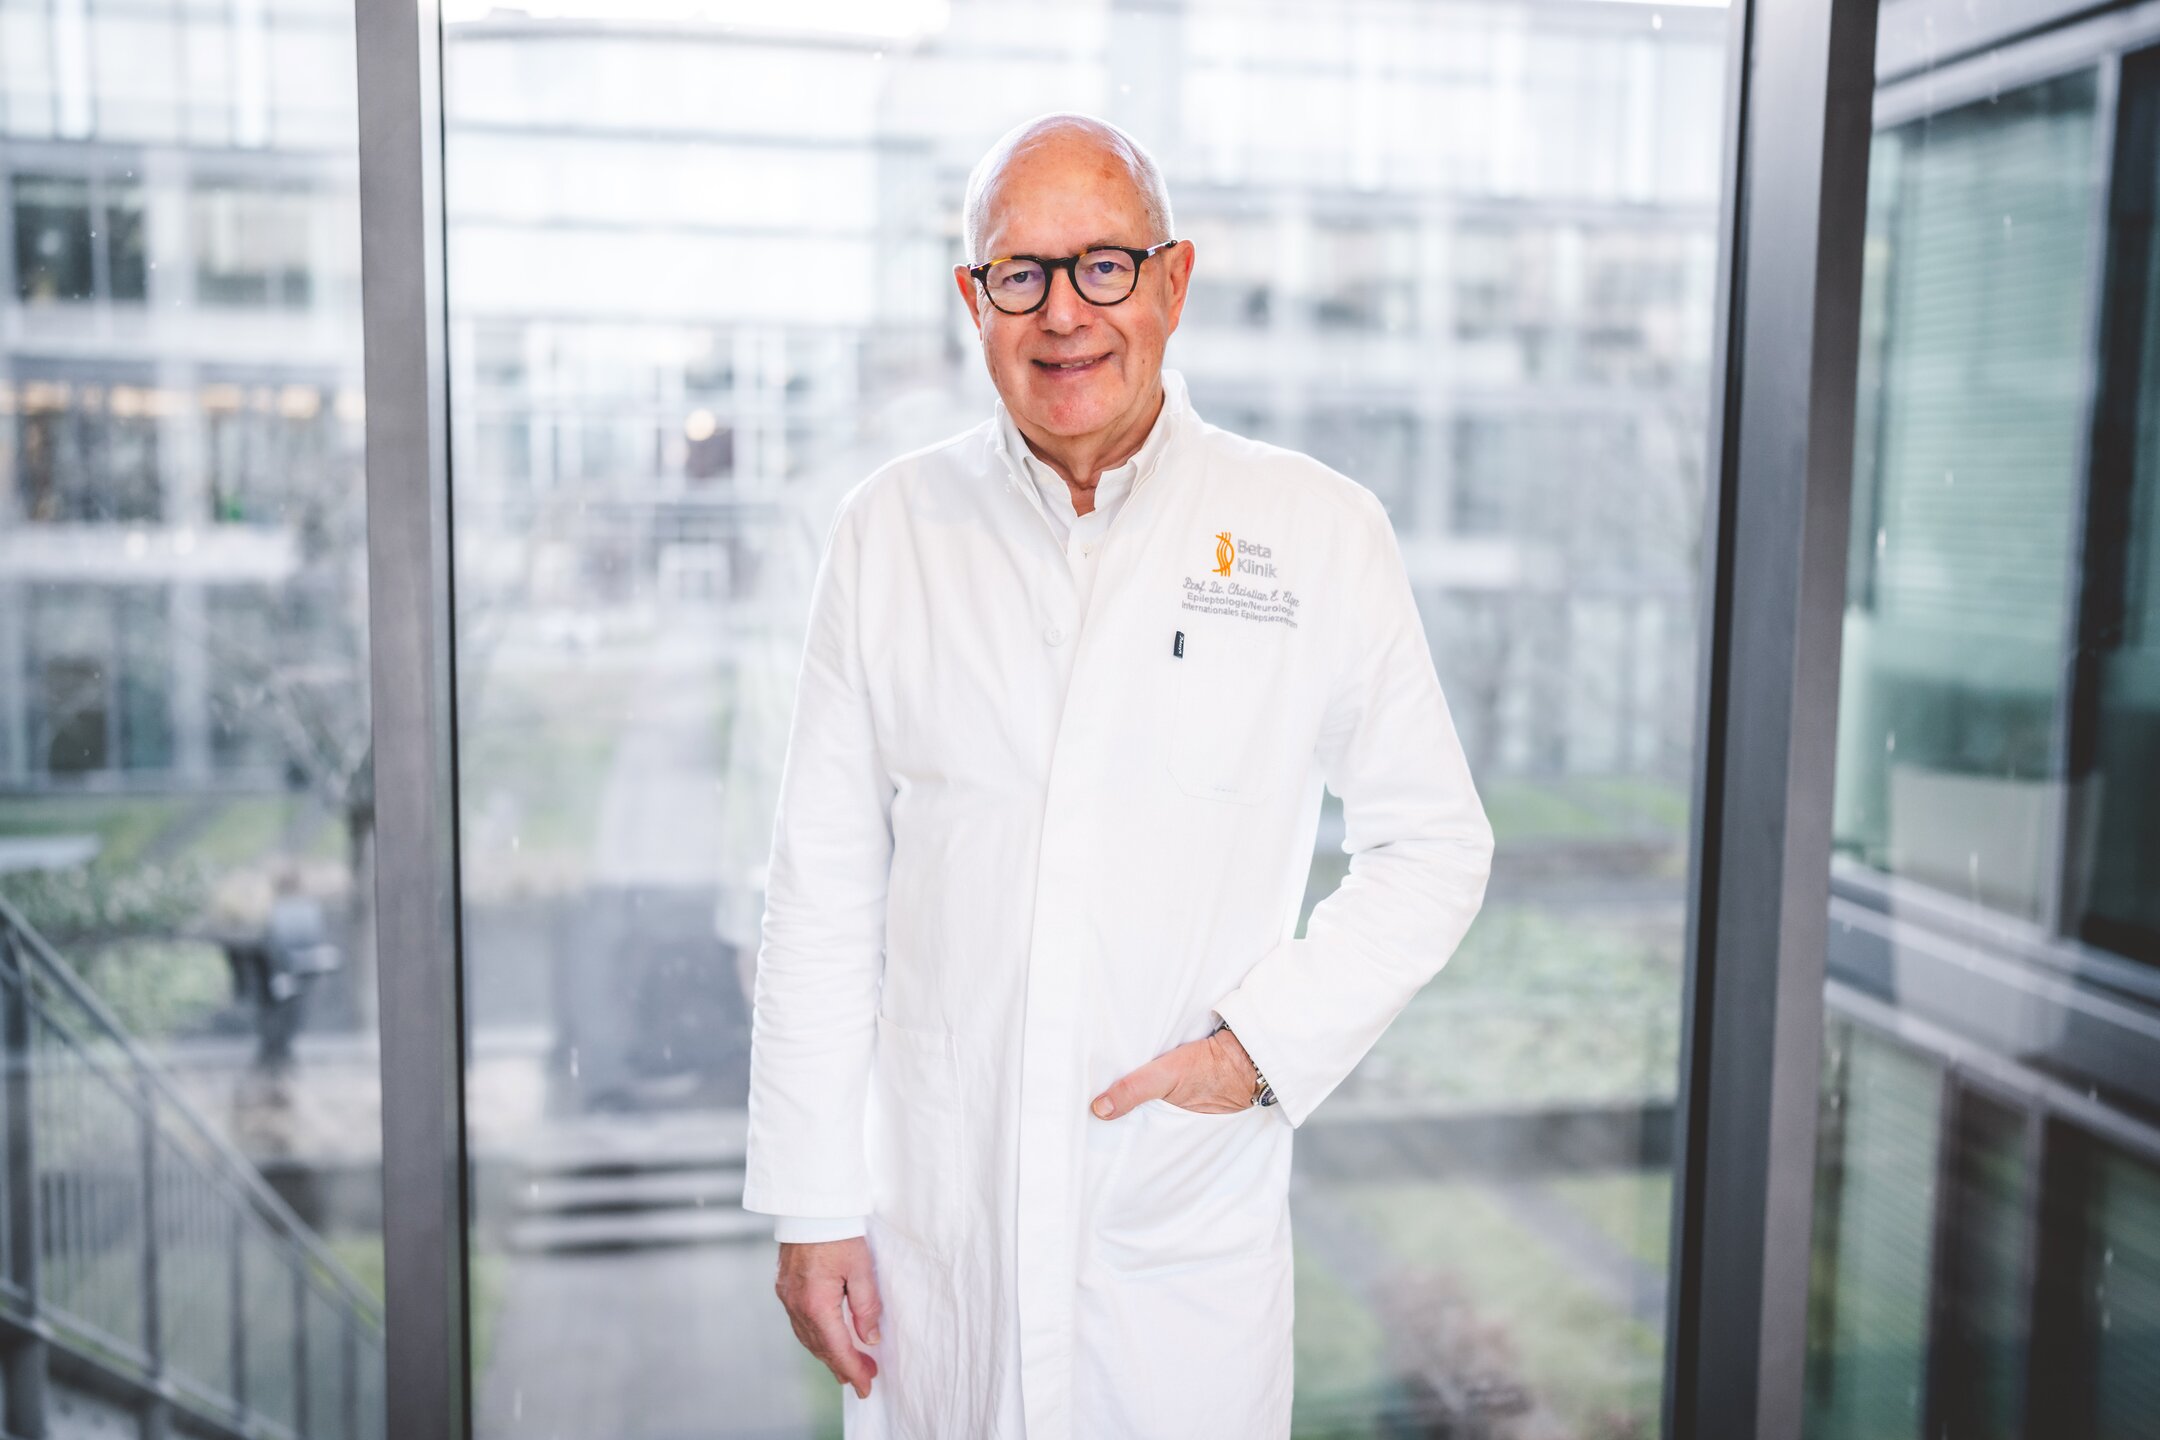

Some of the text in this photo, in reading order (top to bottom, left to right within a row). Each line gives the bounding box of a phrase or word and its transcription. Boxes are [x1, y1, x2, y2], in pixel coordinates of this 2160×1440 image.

[1237, 539, 1272, 559] Beta
[1236, 558, 1278, 579] Klinik
[1227, 582, 1269, 602] Christian
[1181, 600, 1239, 617] Internationales
